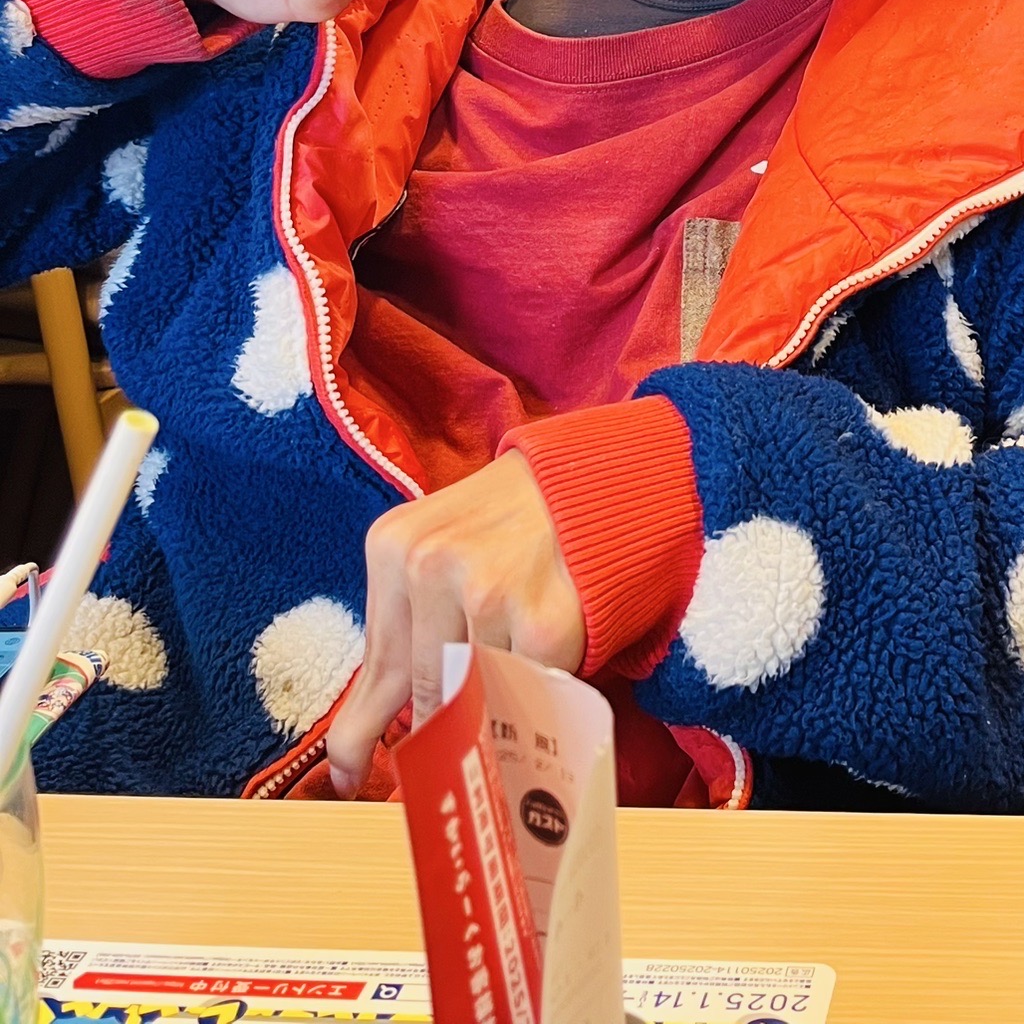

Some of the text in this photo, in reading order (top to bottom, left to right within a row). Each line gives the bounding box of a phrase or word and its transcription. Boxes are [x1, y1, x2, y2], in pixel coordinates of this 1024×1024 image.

[190, 980, 348, 996] エントリー受付中
